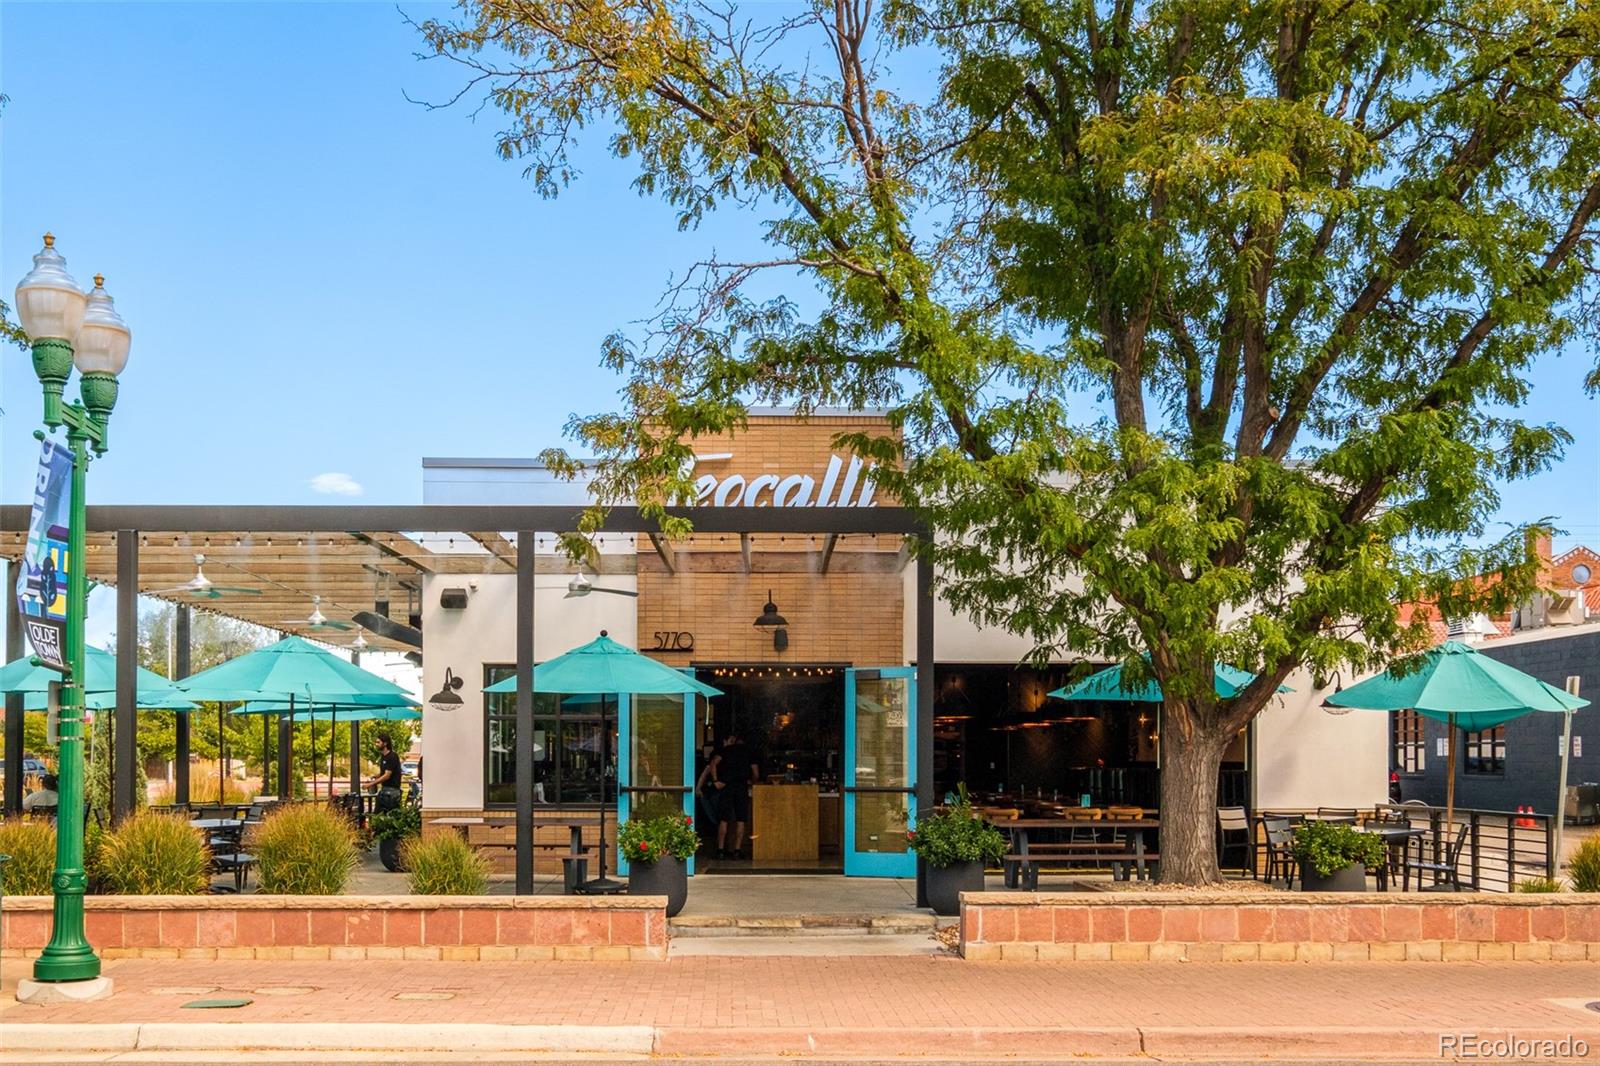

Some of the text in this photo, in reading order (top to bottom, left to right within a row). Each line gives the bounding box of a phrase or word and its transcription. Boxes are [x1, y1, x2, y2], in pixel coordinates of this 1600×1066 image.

[32, 625, 56, 645] OLDE
[654, 632, 694, 650] 5770
[34, 640, 60, 659] TOWN
